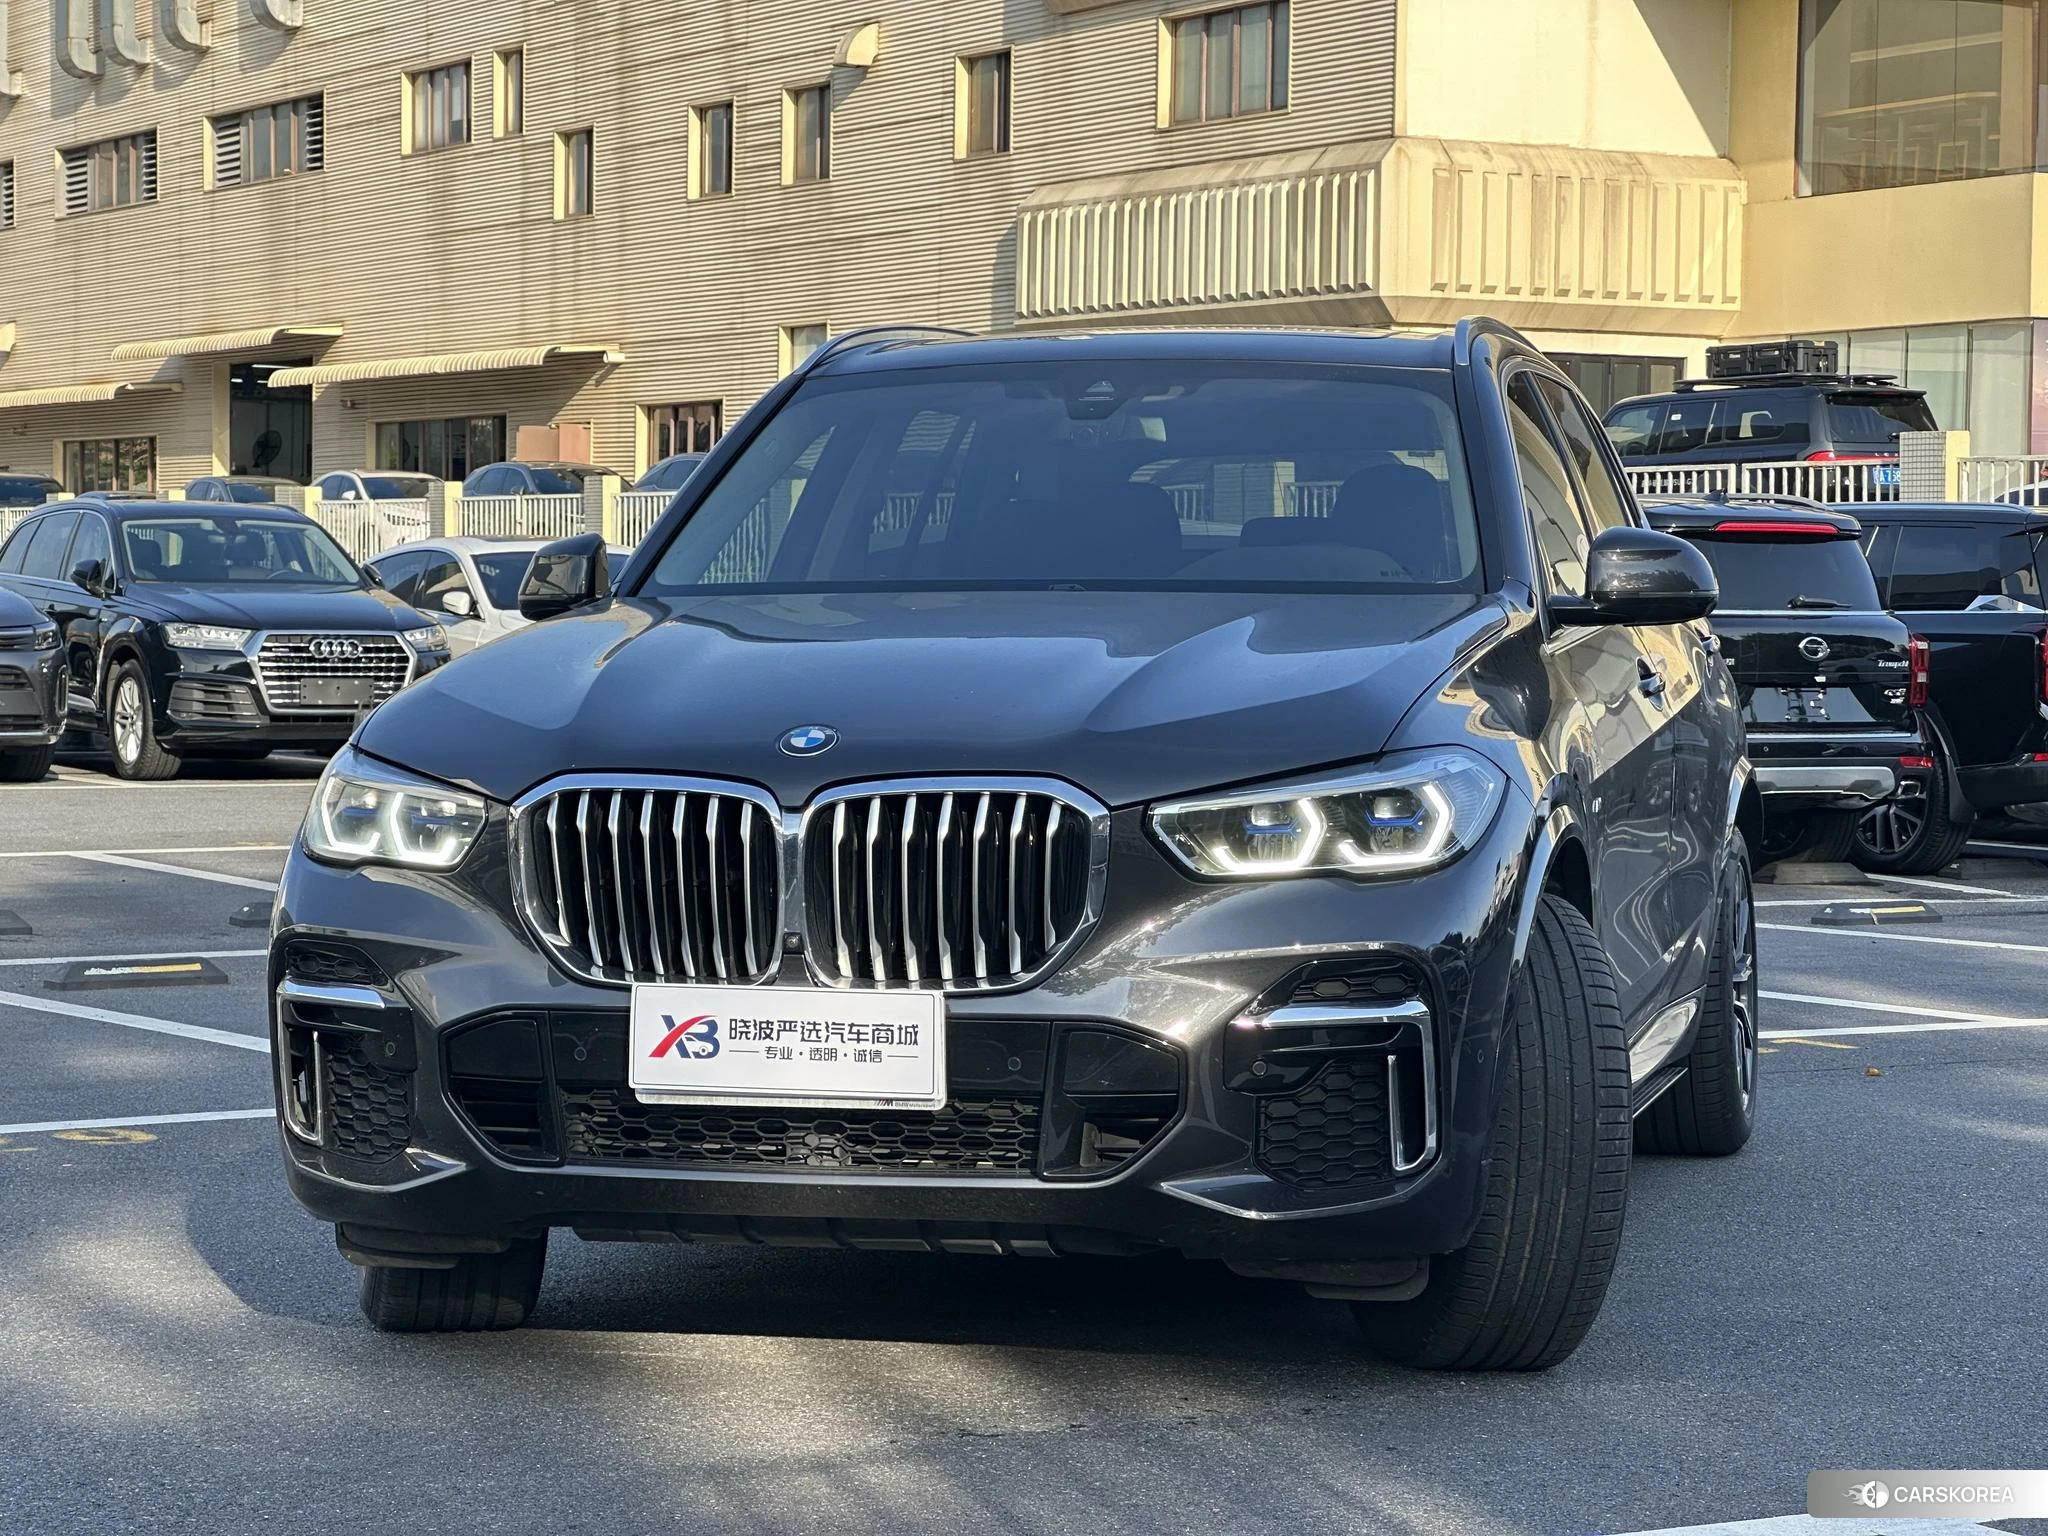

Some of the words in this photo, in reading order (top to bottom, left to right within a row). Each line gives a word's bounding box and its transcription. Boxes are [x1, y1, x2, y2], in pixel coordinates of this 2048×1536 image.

[729, 1018, 920, 1047] 晓波严选汽车商城
